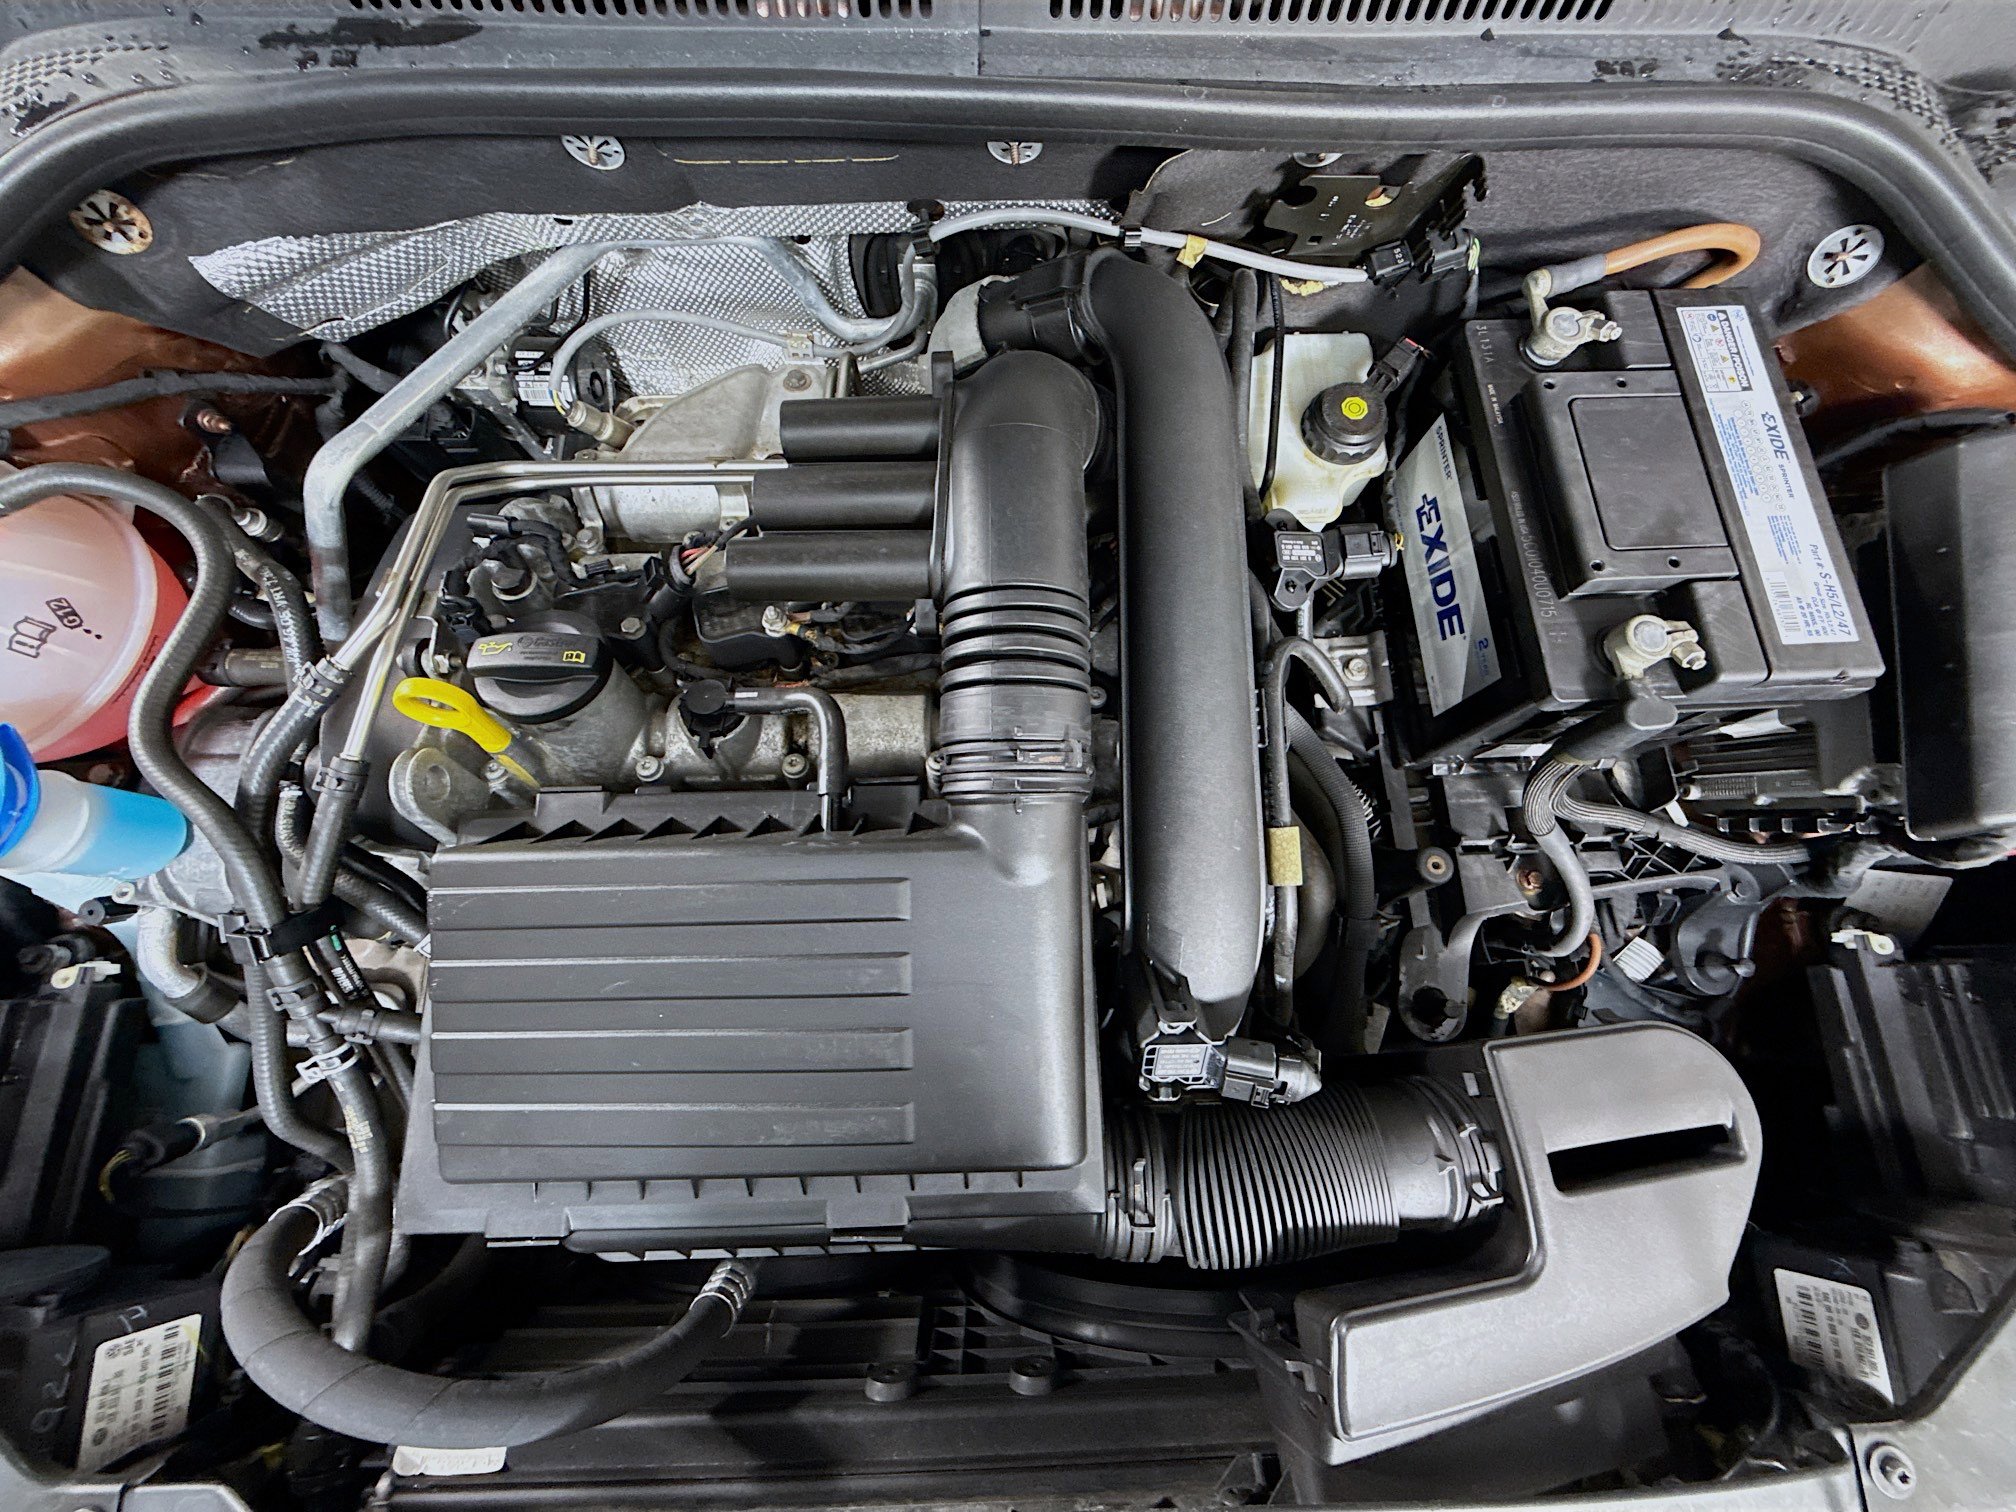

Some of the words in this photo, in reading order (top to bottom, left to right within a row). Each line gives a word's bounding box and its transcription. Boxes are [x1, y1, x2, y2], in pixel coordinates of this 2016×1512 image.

[1720, 321, 1736, 352] DANGER
[1436, 425, 1452, 479] SPRINTER
[1760, 412, 1789, 459] EXIDE
[1778, 464, 1793, 497] SPRINTER
[1415, 494, 1466, 640] EXIDE
[1808, 544, 1821, 559] Part
[1819, 572, 1850, 635] S-H5/L2/47
[49, 598, 81, 626] G12
[1477, 637, 1489, 651] 2
